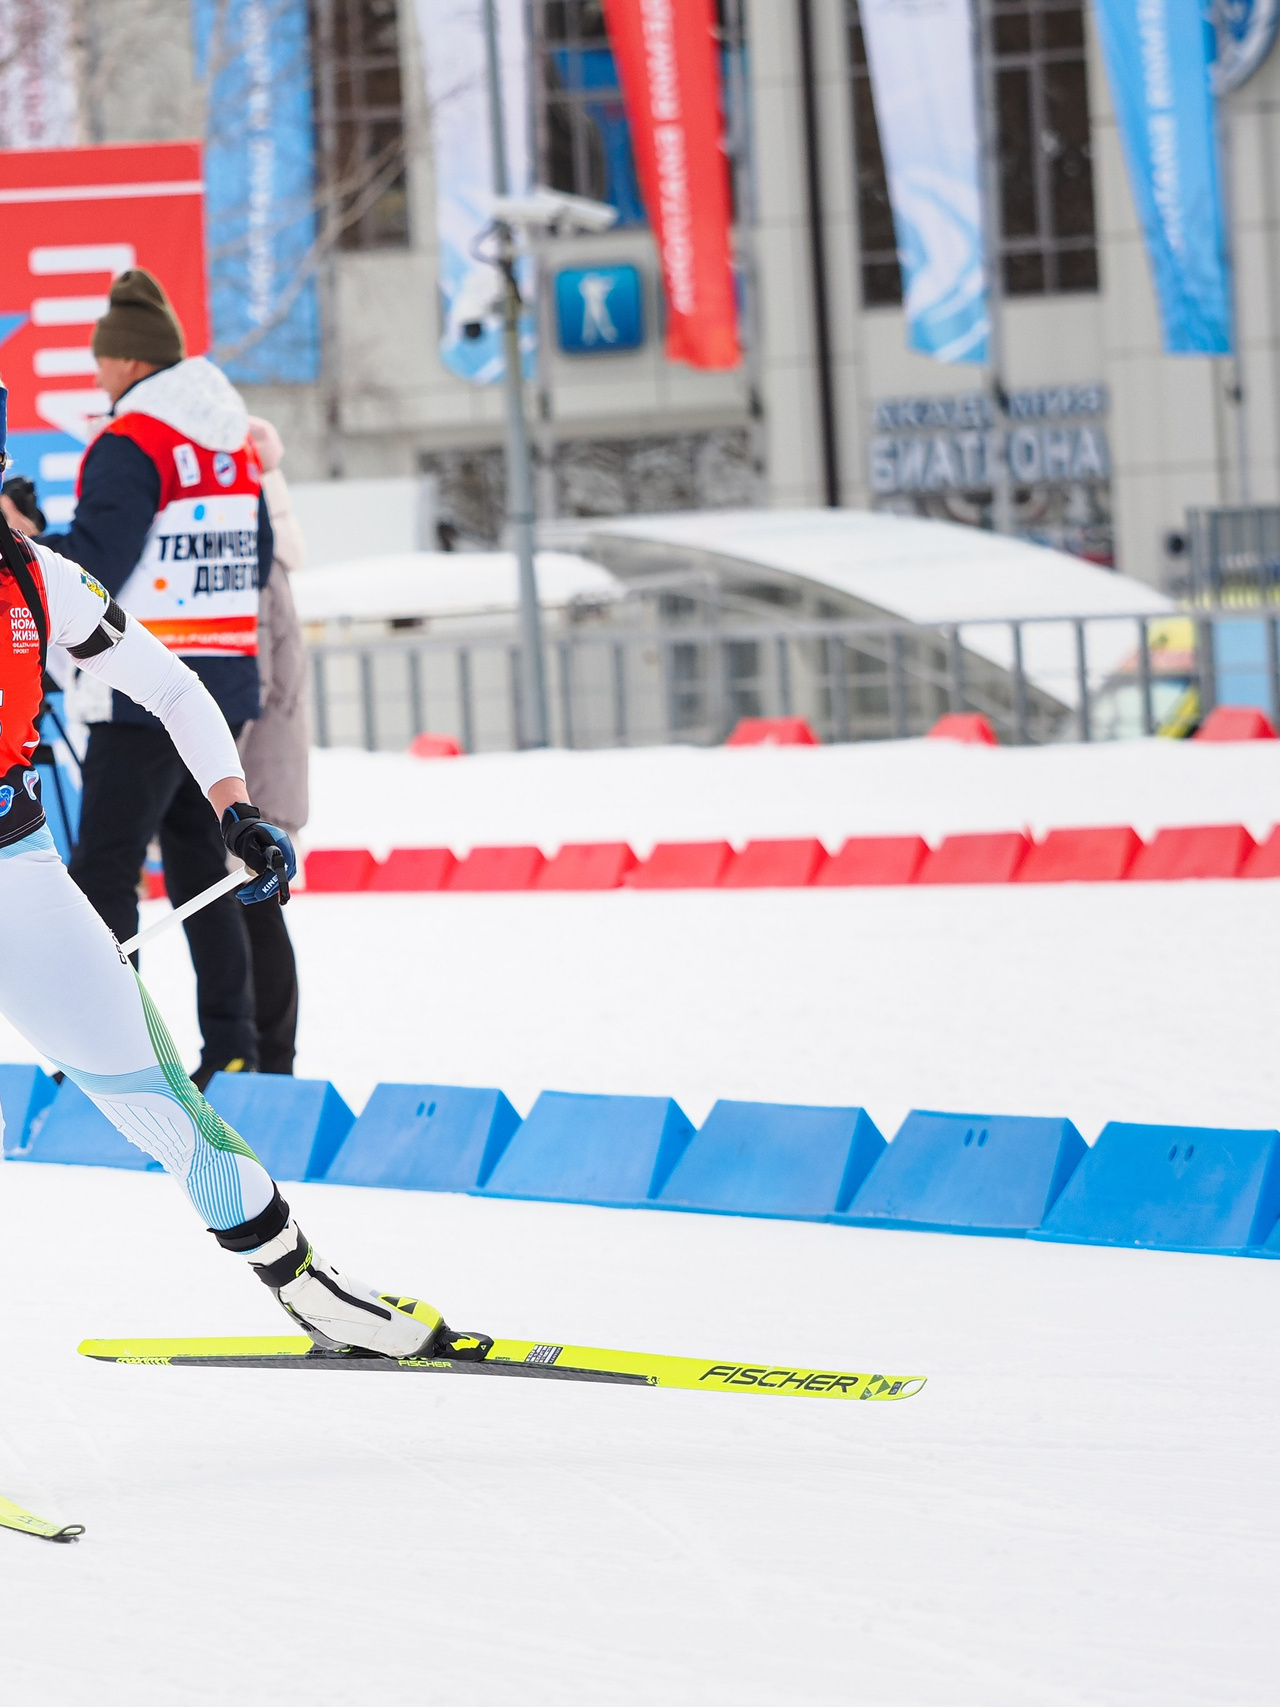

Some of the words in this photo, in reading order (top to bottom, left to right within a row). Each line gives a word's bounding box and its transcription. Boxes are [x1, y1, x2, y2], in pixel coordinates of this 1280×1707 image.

[873, 384, 1106, 430] АКАДМИЯ
[869, 424, 1110, 490] БИАТОНА
[158, 531, 257, 561] ТЕХНИЧЕС
[10, 607, 32, 618] СПО
[11, 619, 37, 630] НОРМ
[261, 874, 279, 894] KINE
[397, 1360, 452, 1368] FISCHER
[697, 1365, 859, 1394] FISCHER
